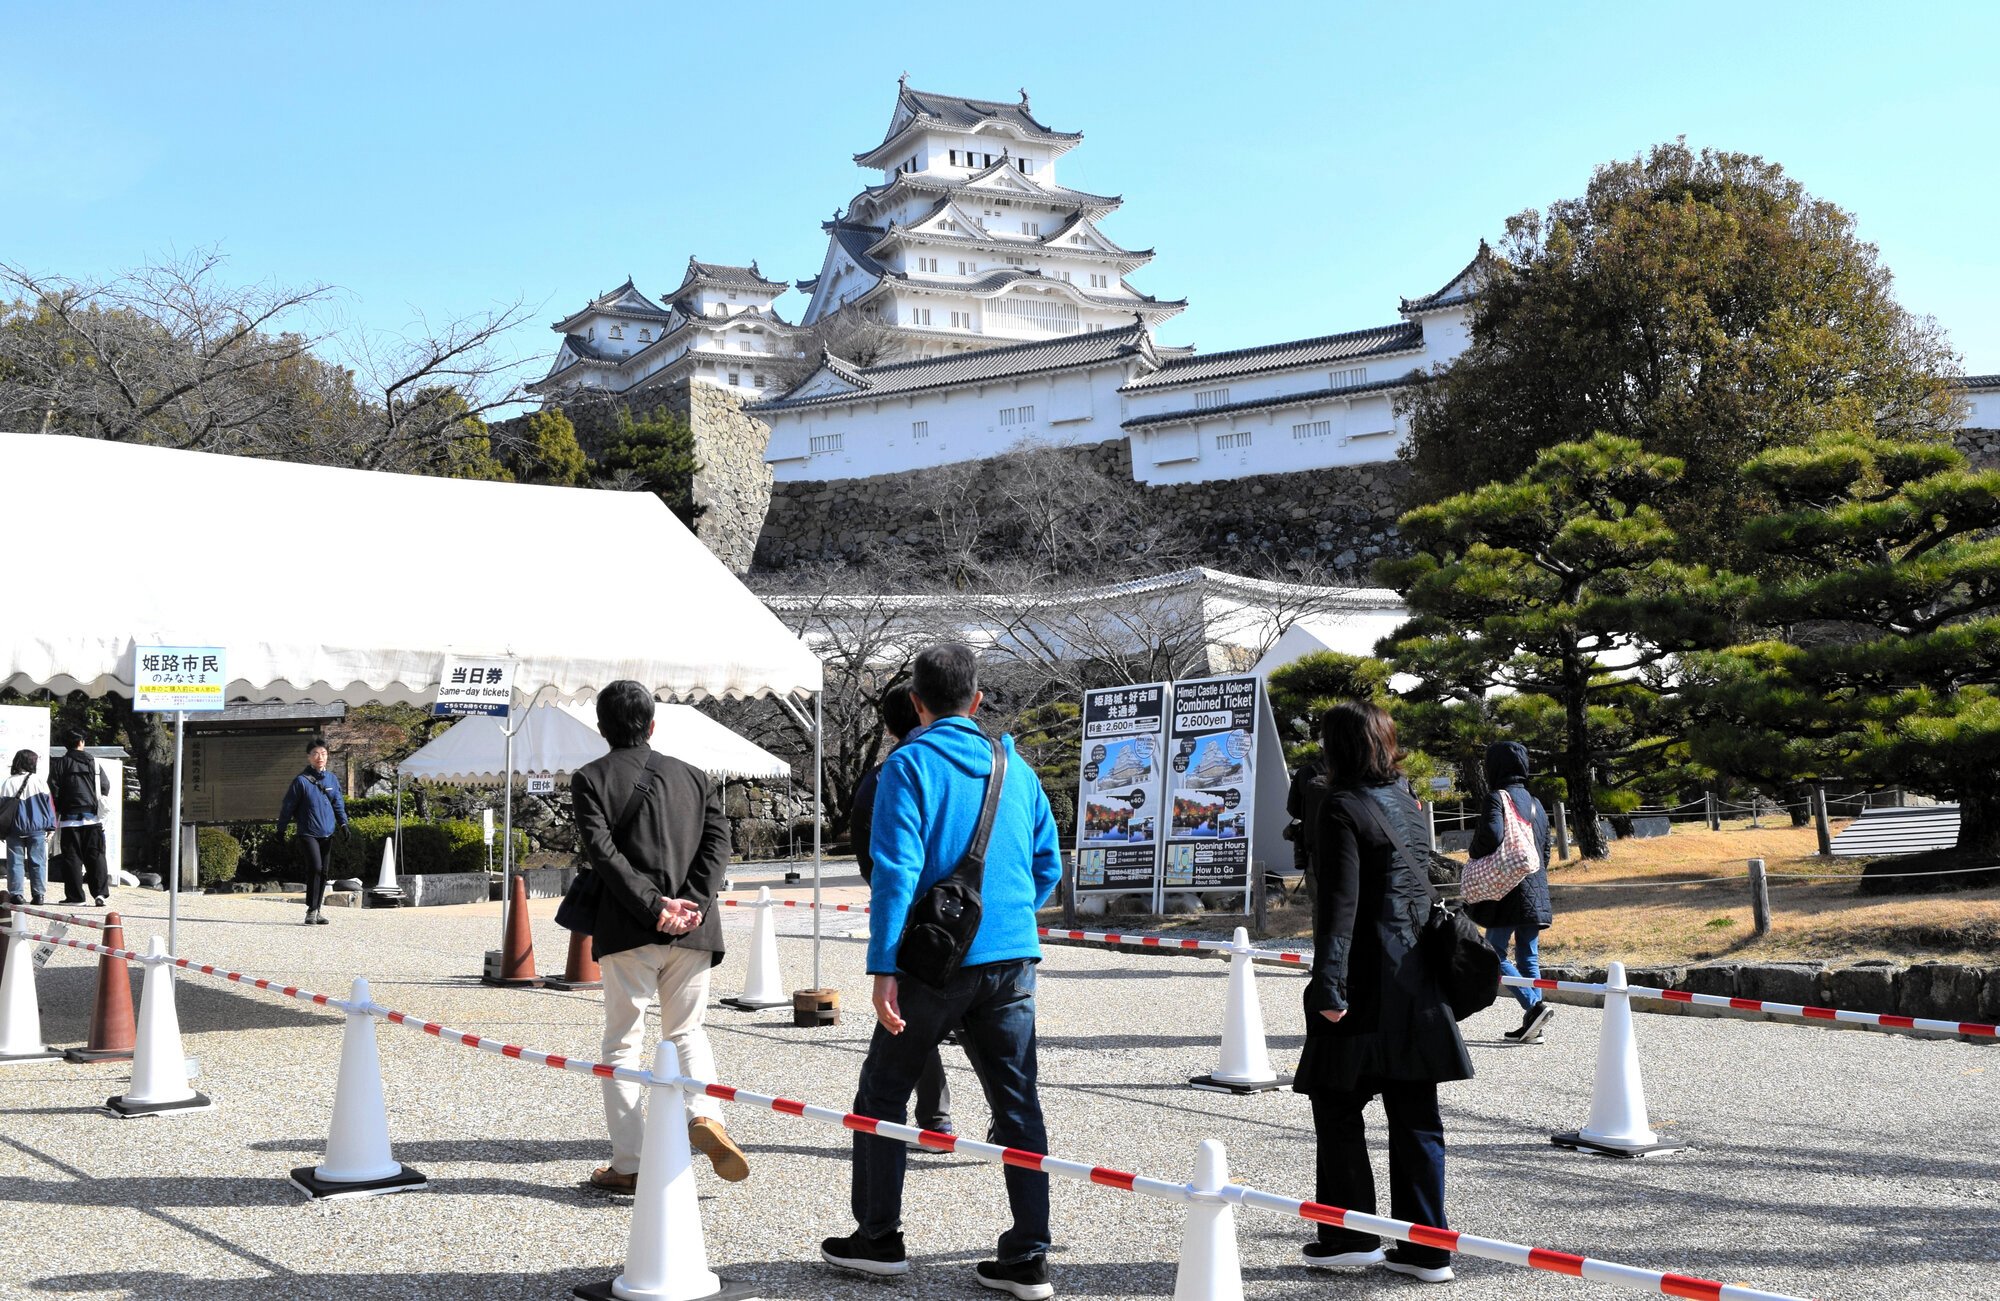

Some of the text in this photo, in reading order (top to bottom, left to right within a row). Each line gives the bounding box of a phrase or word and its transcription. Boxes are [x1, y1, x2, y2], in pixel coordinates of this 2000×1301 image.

[142, 654, 218, 672] 姫路市民
[152, 673, 206, 683] のみなさま
[451, 667, 503, 684] 当日券
[439, 687, 510, 697] Same-day tickets
[1177, 682, 1253, 698] Himeji Castle & Koko-en
[1094, 689, 1158, 706] 姫路城・好古園
[1176, 693, 1252, 712] Combined Ticket
[1108, 704, 1138, 718] 共通券
[1181, 715, 1226, 728] 2,600yen
[532, 780, 551, 790] 団体
[1195, 841, 1245, 850] Opening Hours
[1195, 866, 1212, 874] How
[1223, 865, 1234, 873] Go
